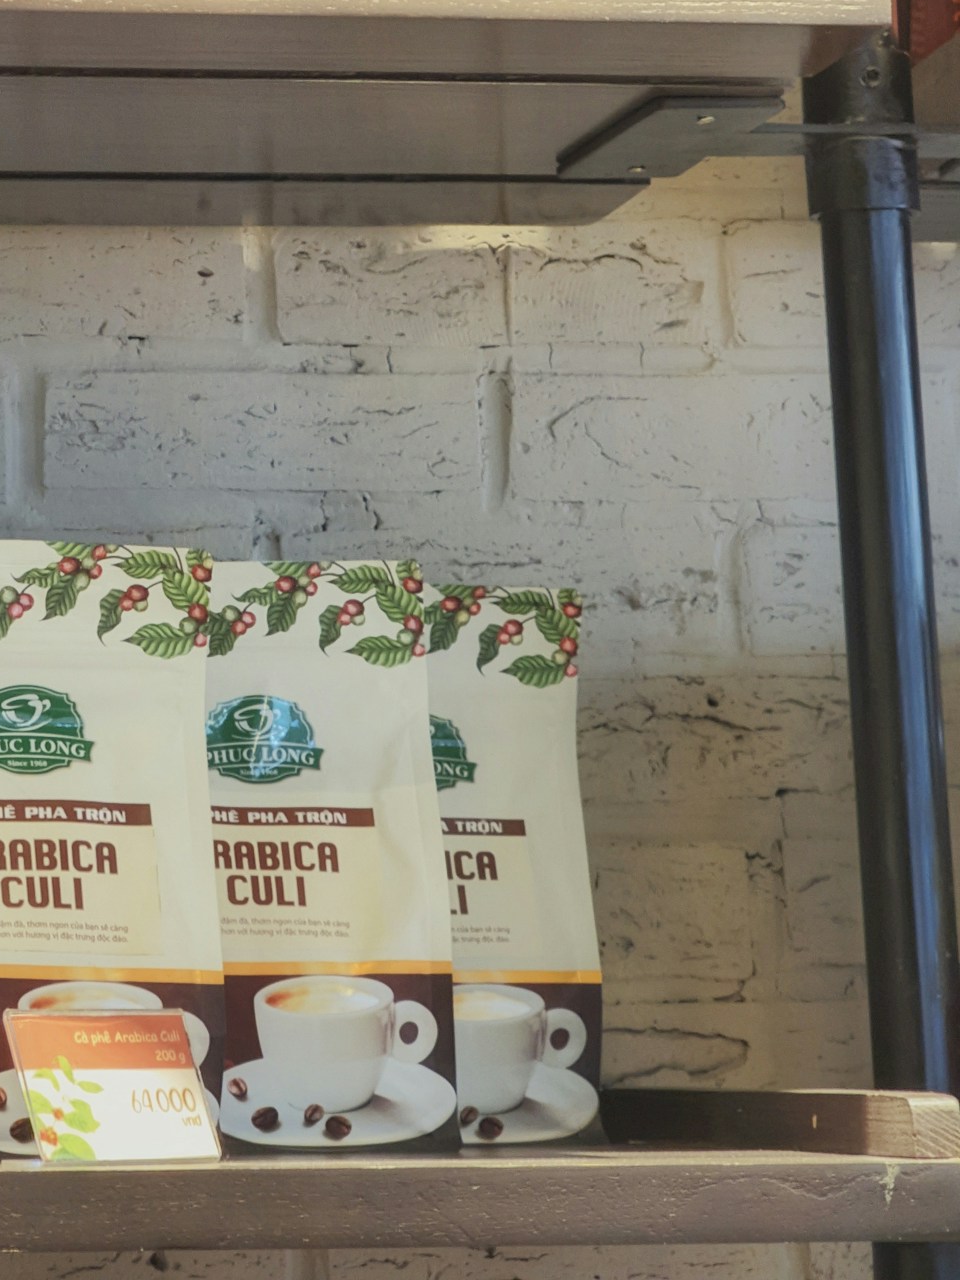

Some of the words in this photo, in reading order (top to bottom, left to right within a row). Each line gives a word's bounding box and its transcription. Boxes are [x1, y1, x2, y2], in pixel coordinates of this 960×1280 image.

[29, 738, 86, 758] LONG
[261, 747, 315, 765] LONG
[435, 762, 468, 778] NG
[24, 806, 68, 820] PHA
[73, 807, 126, 825] TRỘN
[247, 811, 289, 823] PHA
[294, 809, 347, 825] TRỘN
[455, 820, 503, 835] TRỘN
[213, 839, 340, 873] RABICA
[0, 876, 84, 910] CULI
[226, 875, 307, 907] CULI
[114, 1031, 158, 1043] Arabica
[160, 1030, 180, 1042] Culi
[154, 1049, 177, 1062] 200
